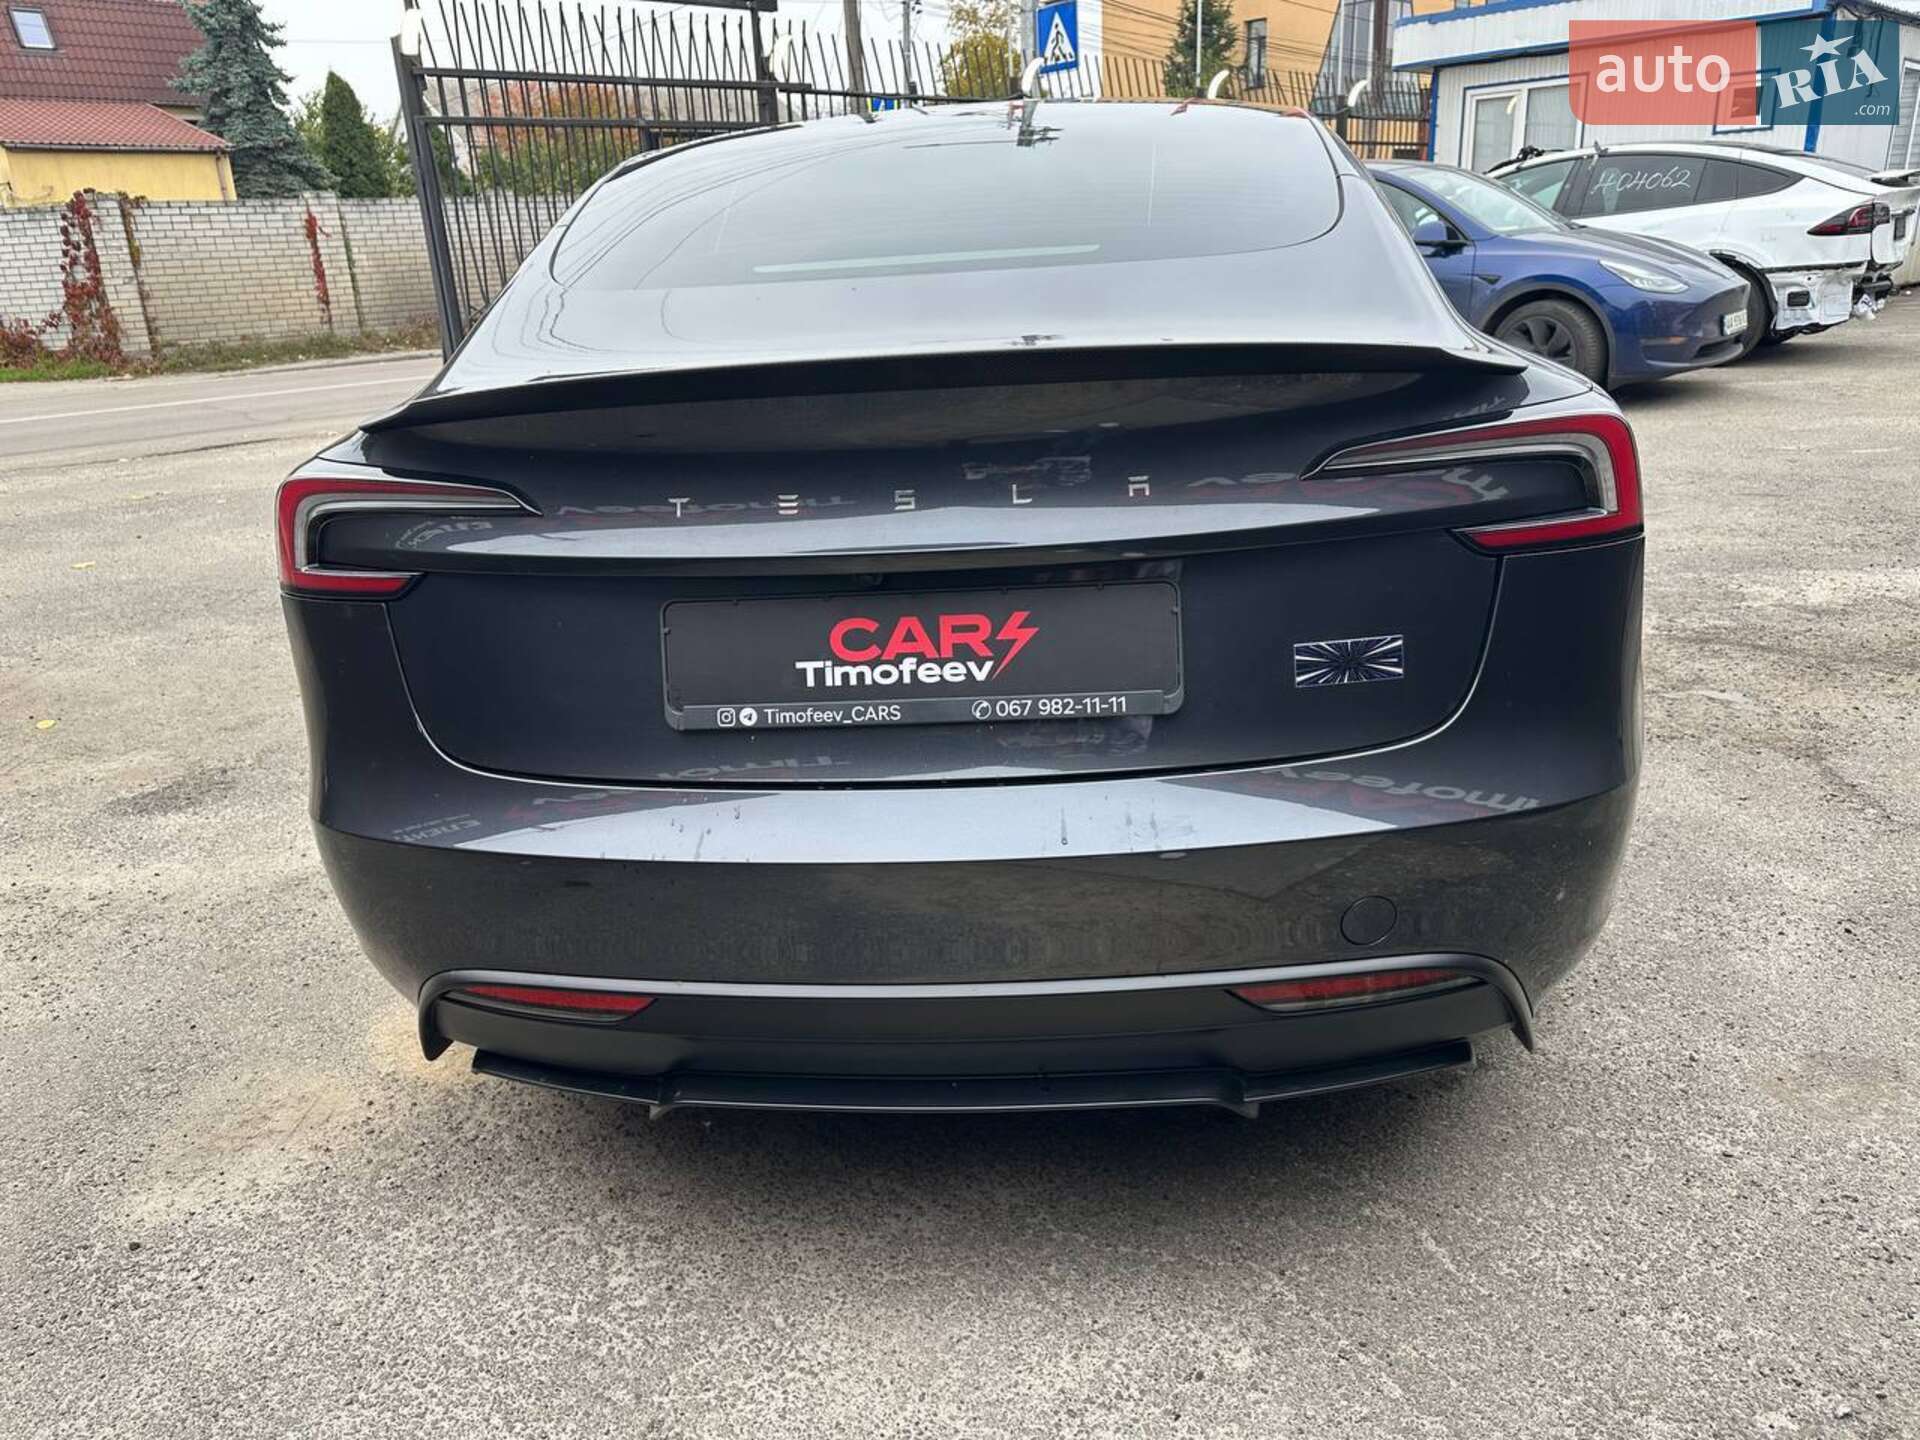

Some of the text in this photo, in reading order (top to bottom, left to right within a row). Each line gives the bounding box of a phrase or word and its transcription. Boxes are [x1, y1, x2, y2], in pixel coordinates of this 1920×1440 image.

[795, 657, 994, 687] Timofeev
[764, 705, 901, 724] Timofeev_CARS
[996, 696, 1127, 717] 067 982-11-11
